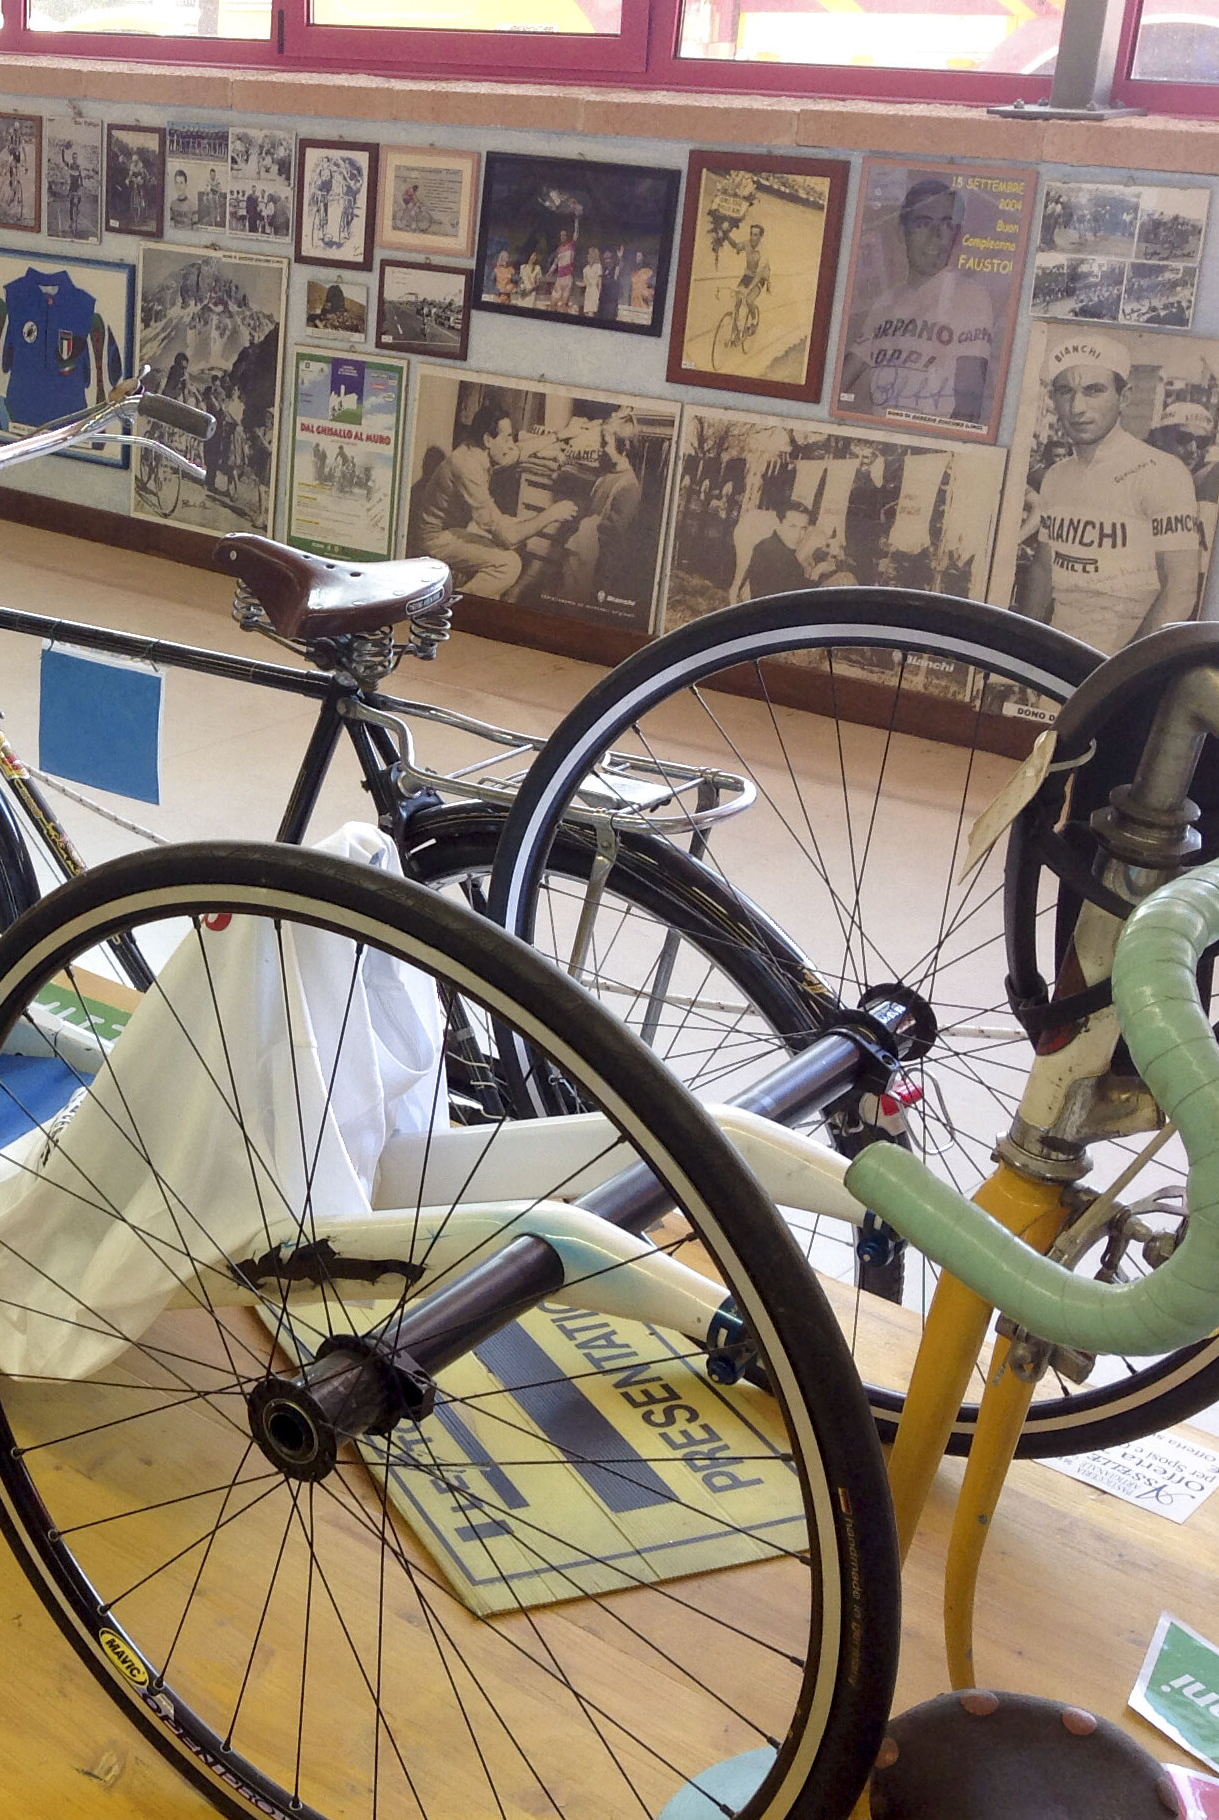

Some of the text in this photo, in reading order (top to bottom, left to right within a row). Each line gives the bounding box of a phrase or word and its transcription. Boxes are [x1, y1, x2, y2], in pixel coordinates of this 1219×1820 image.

[966, 178, 1026, 195] SETTEMBRE
[998, 198, 1023, 211] 2004
[996, 219, 1019, 234] Buon
[962, 234, 1016, 252] Compleanno
[957, 255, 1013, 274] FAUSTO!
[1053, 344, 1101, 363] BIANCHI
[300, 422, 391, 446] DAL GHISALLO AL MURO
[906, 654, 955, 673] Bianchi
[1017, 707, 1047, 720] DONO
[1121, 1452, 1205, 1492] Offerta
[1147, 1451, 1188, 1474] sposi
[1189, 1470, 1217, 1484] per
[105, 1637, 142, 1679] MAVIC
